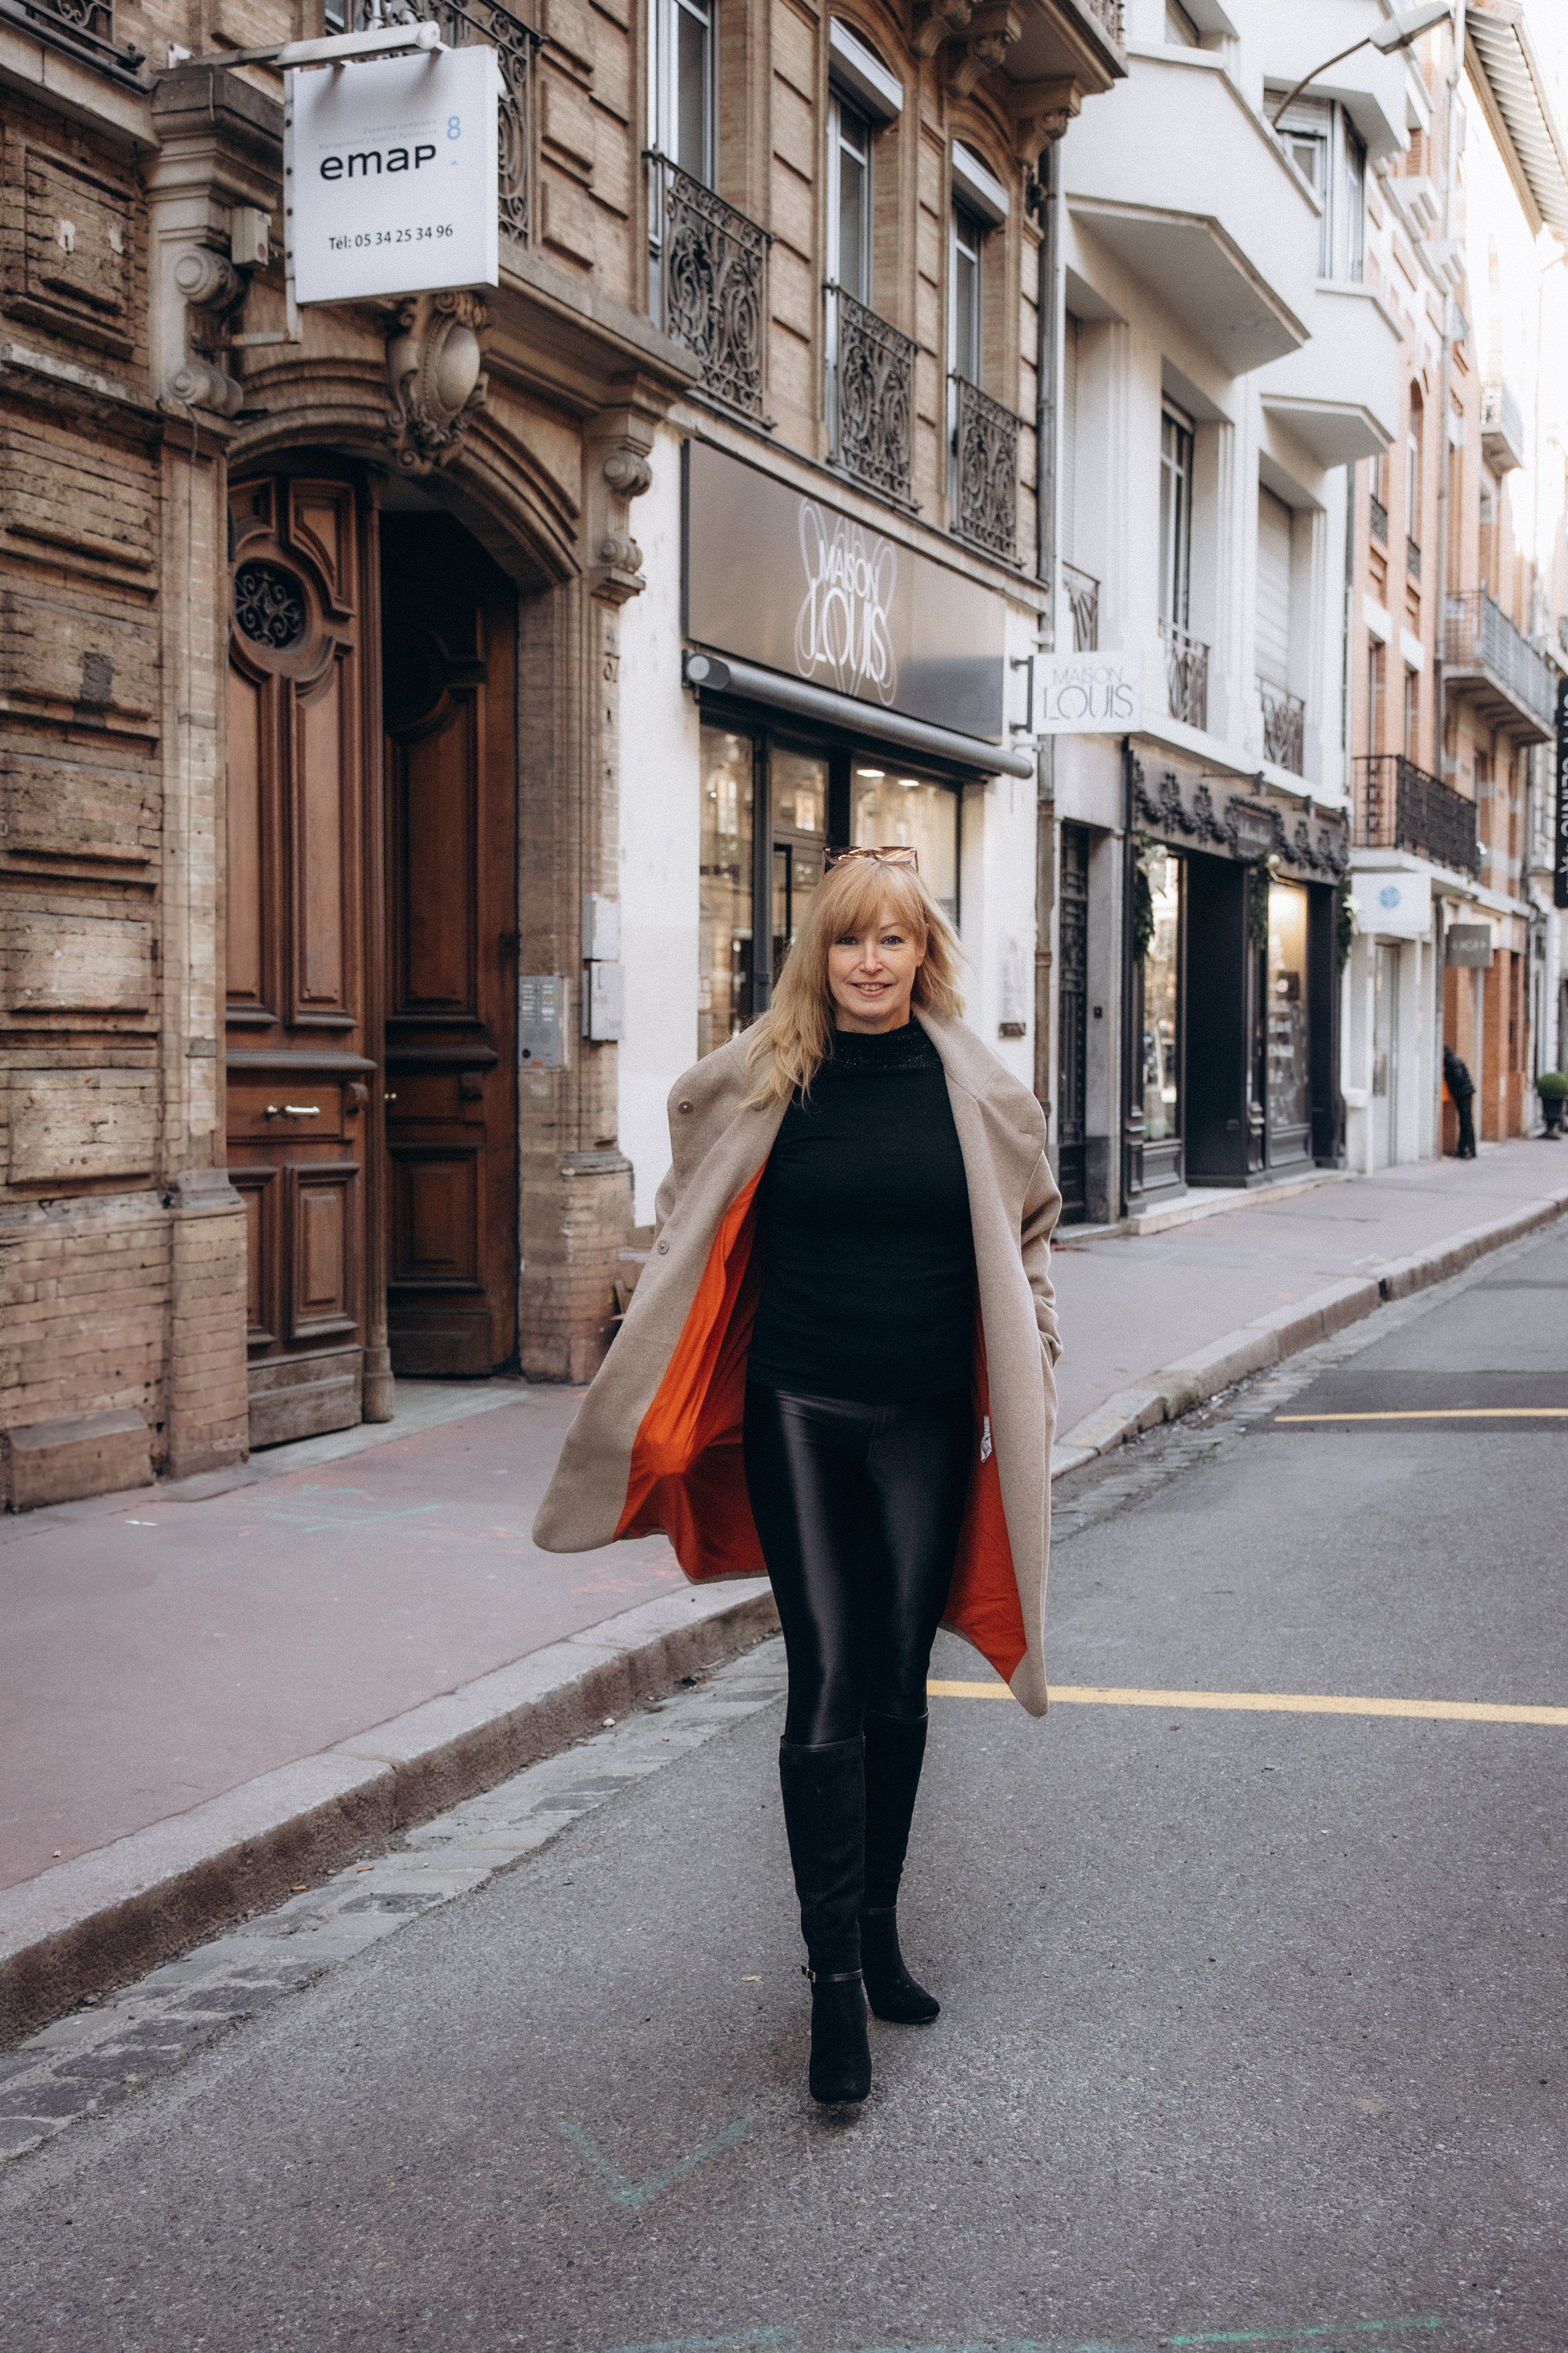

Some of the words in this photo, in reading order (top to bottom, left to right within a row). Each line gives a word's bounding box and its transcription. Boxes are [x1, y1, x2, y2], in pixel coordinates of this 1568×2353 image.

[355, 234, 371, 247] 05
[375, 232, 391, 245] 34
[396, 229, 412, 243] 25
[417, 227, 432, 240] 34
[437, 224, 453, 238] 96
[819, 539, 880, 605] MAISON
[810, 577, 887, 683] LOUIS
[1043, 684, 1133, 720] LOUIS
